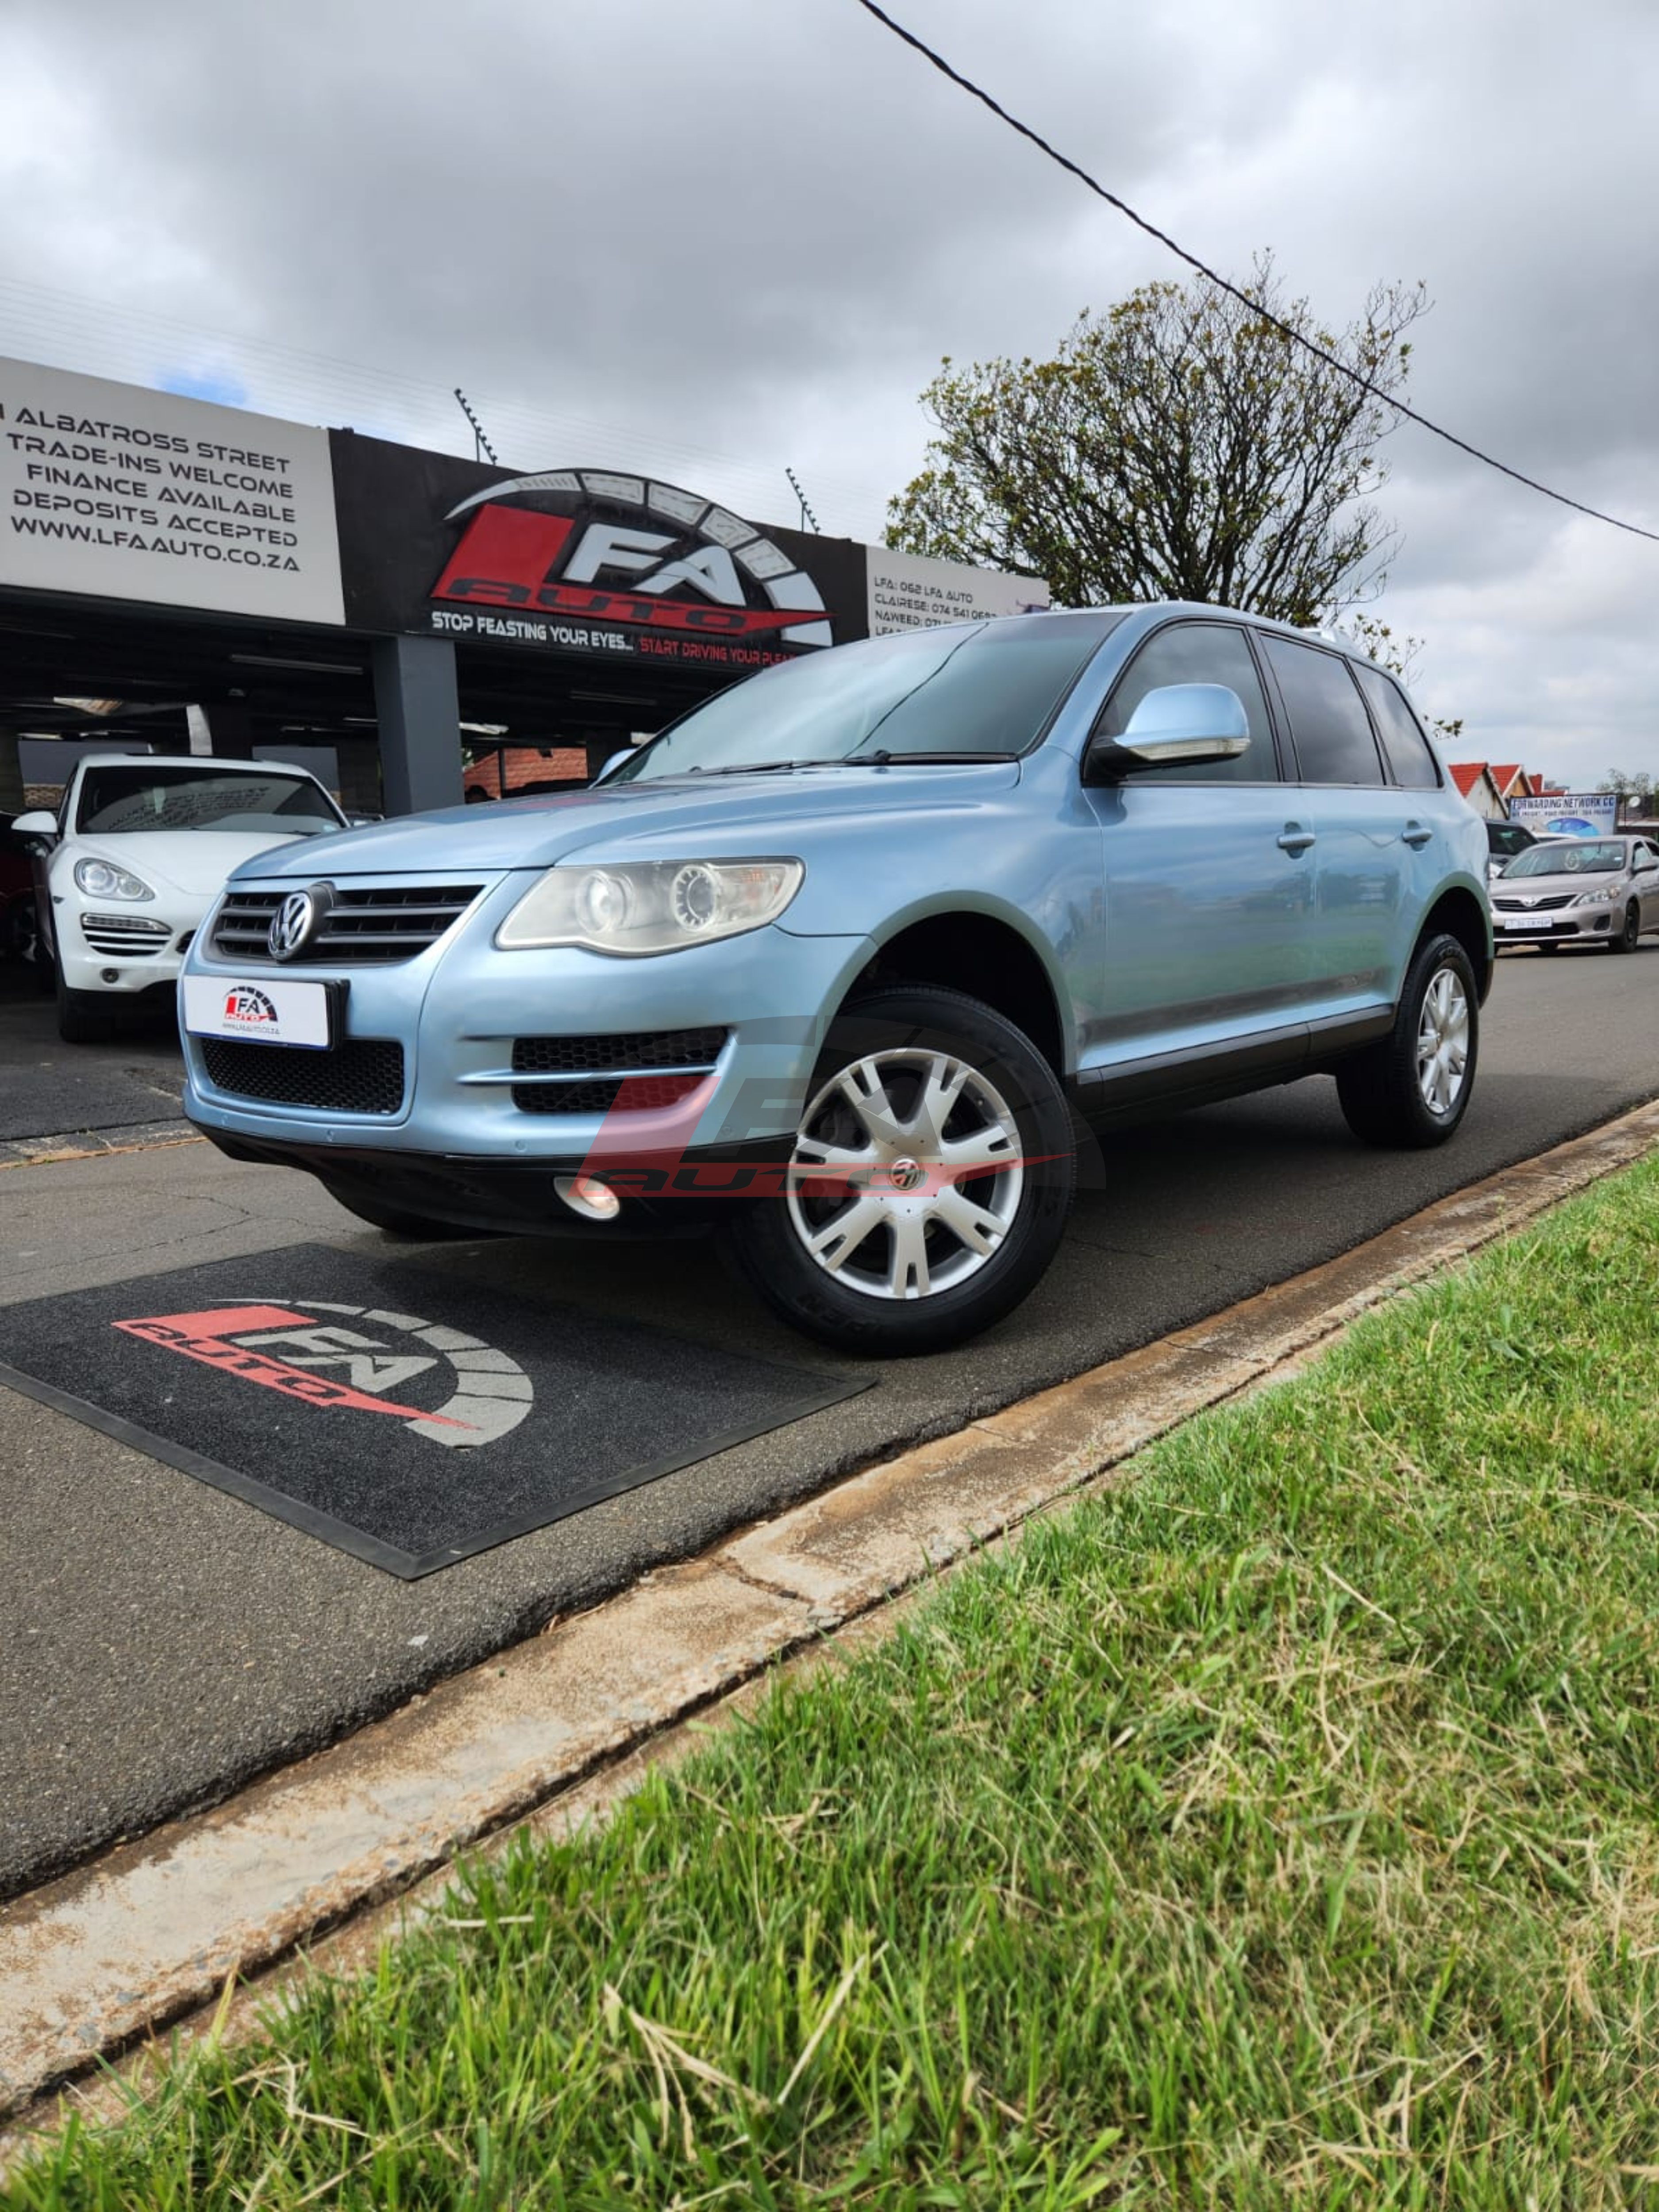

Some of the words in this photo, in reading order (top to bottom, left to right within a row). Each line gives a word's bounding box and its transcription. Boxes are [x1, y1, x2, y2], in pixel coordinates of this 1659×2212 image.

[6, 433, 162, 474] TRADE-INS
[169, 462, 293, 498] WELCOME
[15, 407, 189, 454] ALBATROSS
[197, 442, 290, 474] STREET
[13, 489, 158, 526] DEPOSITS
[167, 514, 298, 547] ACCEPTED
[27, 463, 148, 498] FINANCE
[158, 486, 296, 523] AVAILABLE
[11, 515, 300, 572] WWW.LFAAUTO.CO.ZA
[447, 578, 747, 629] AUTO
[874, 577, 897, 590] LFA:
[900, 581, 922, 595] 062
[924, 586, 943, 599] LFA
[946, 591, 973, 604] AUTO
[875, 593, 929, 612] CLAIRESE:
[932, 603, 951, 615] 074
[953, 607, 970, 618] 541
[431, 611, 473, 631] STOP
[477, 616, 547, 641] FEASTING
[549, 624, 589, 646] YOUR
[639, 637, 679, 655] START
[682, 642, 727, 661] DRIVING
[730, 649, 761, 665] YOUR
[1513, 798, 1562, 809] FORWARDING
[1563, 797, 1600, 808] NETWORK
[128, 1323, 347, 1400] AUTO
